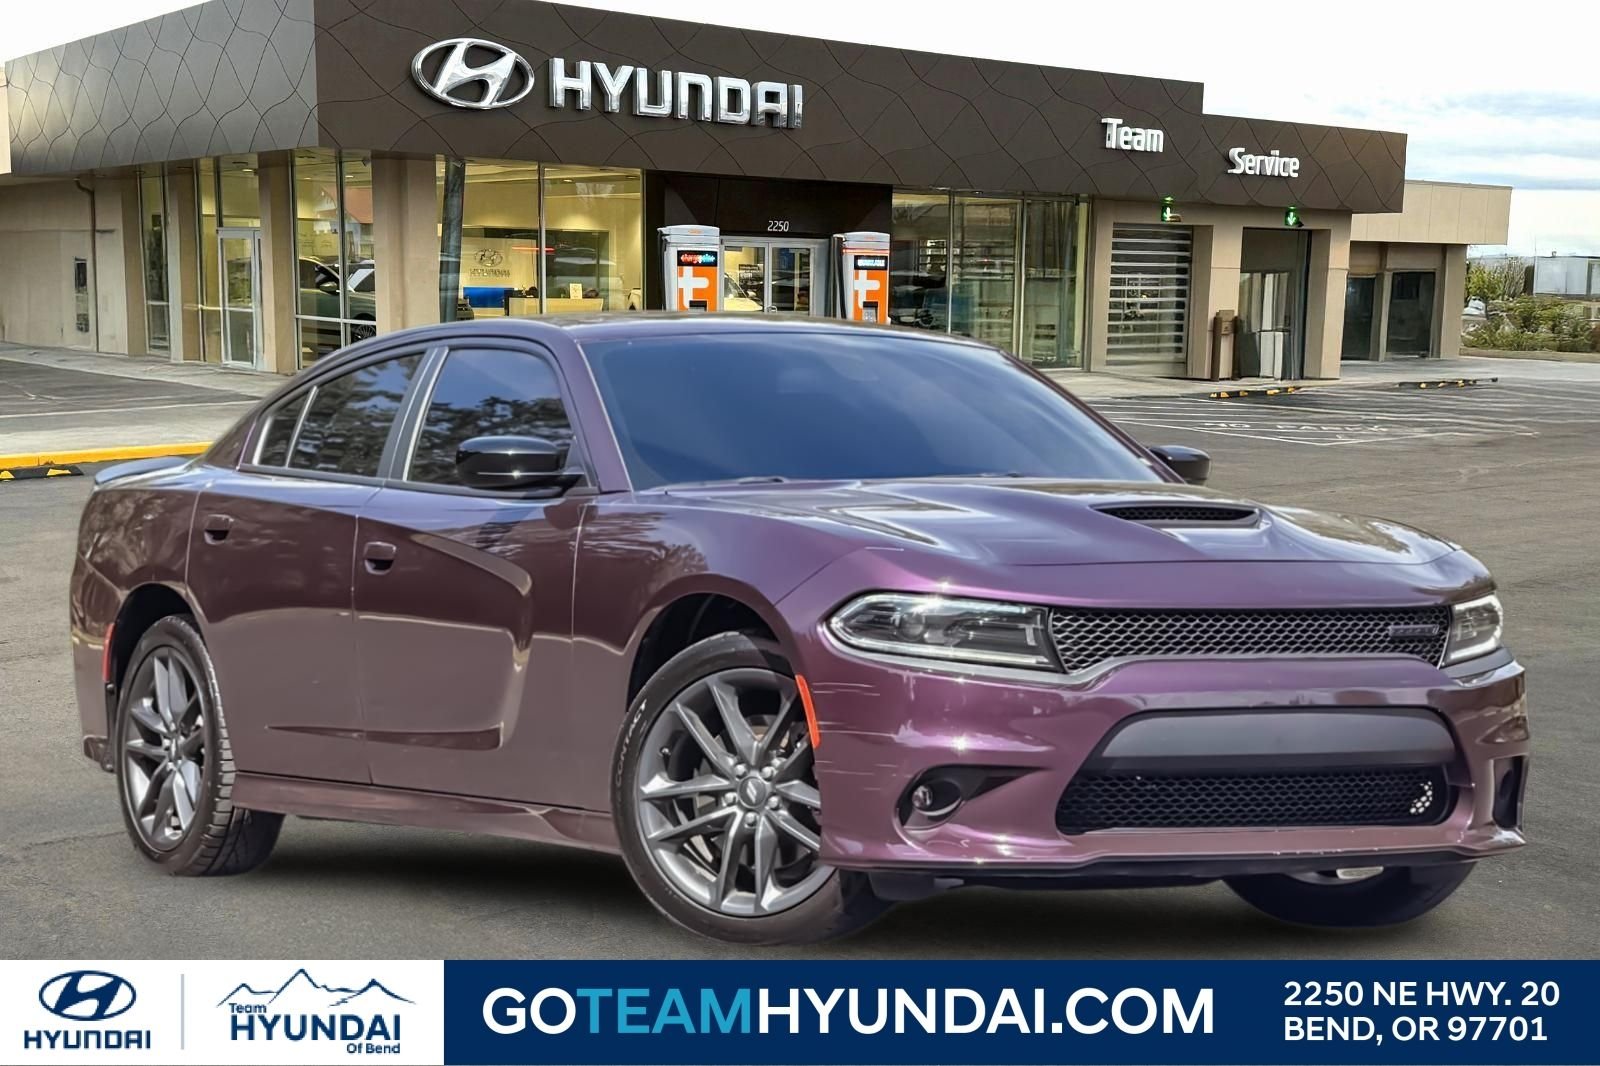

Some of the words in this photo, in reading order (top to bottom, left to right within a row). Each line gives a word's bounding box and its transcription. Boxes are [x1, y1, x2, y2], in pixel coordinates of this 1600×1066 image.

[549, 57, 803, 129] HYUNDAI
[1101, 117, 1164, 152] Team
[1227, 147, 1300, 178] Service
[767, 220, 790, 232] 2250
[615, 698, 648, 787] CONTACT
